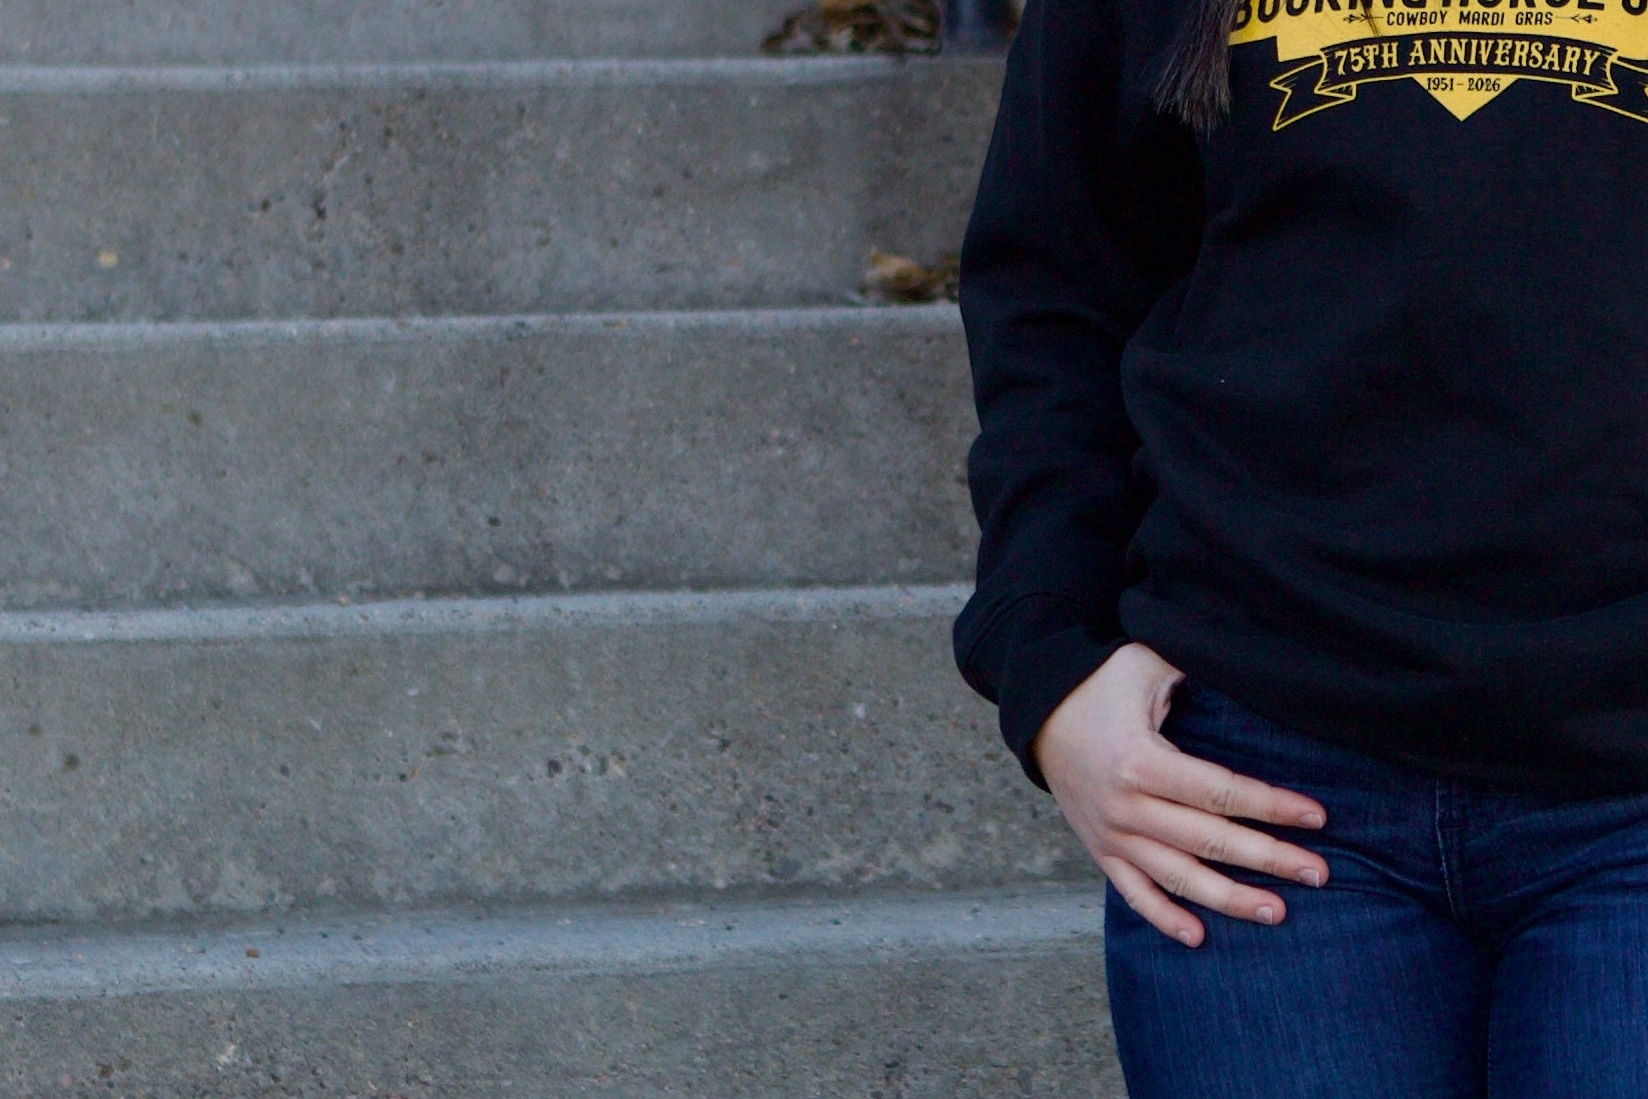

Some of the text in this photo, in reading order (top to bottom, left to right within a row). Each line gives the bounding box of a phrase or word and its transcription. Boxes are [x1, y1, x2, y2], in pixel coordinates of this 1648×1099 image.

[1386, 11, 1554, 26] COWBOY MARDI GRAS
[1334, 37, 1601, 76] 75TH ANNIVERSARY
